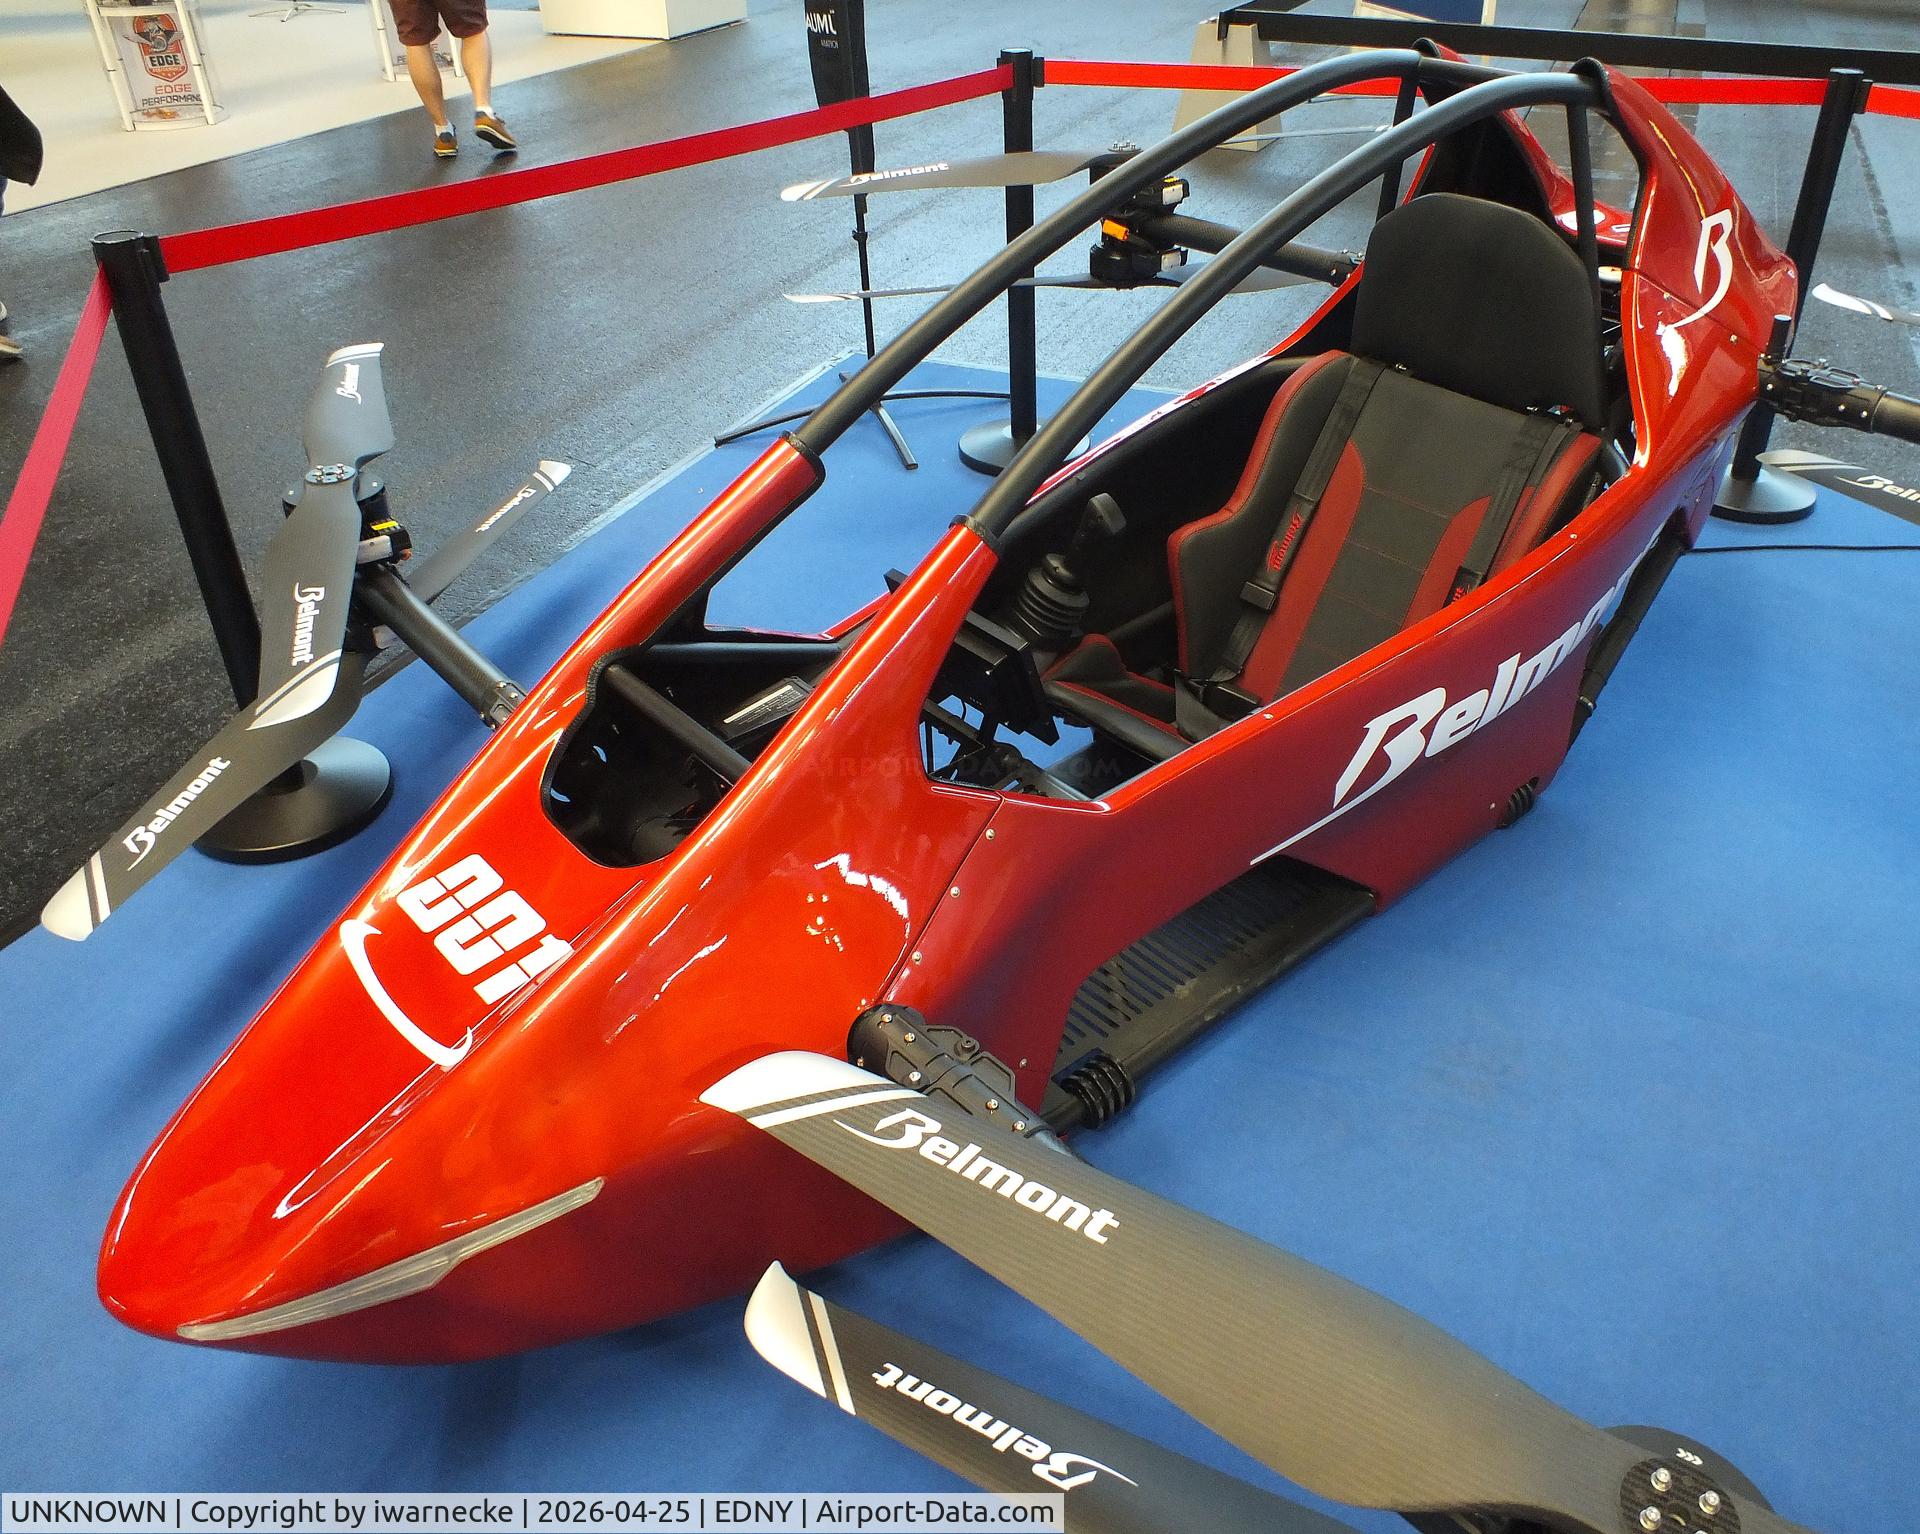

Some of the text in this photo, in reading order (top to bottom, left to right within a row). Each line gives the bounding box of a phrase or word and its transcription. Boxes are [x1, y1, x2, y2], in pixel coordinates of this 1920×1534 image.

[142, 94, 202, 107] PERFORMAN
[149, 54, 180, 67] EDGE
[155, 83, 192, 94] EDGE
[291, 582, 326, 667] Belmont
[122, 756, 231, 872] Belmont
[832, 1108, 1121, 1245] Belmont
[871, 1361, 1139, 1492] Belmont
